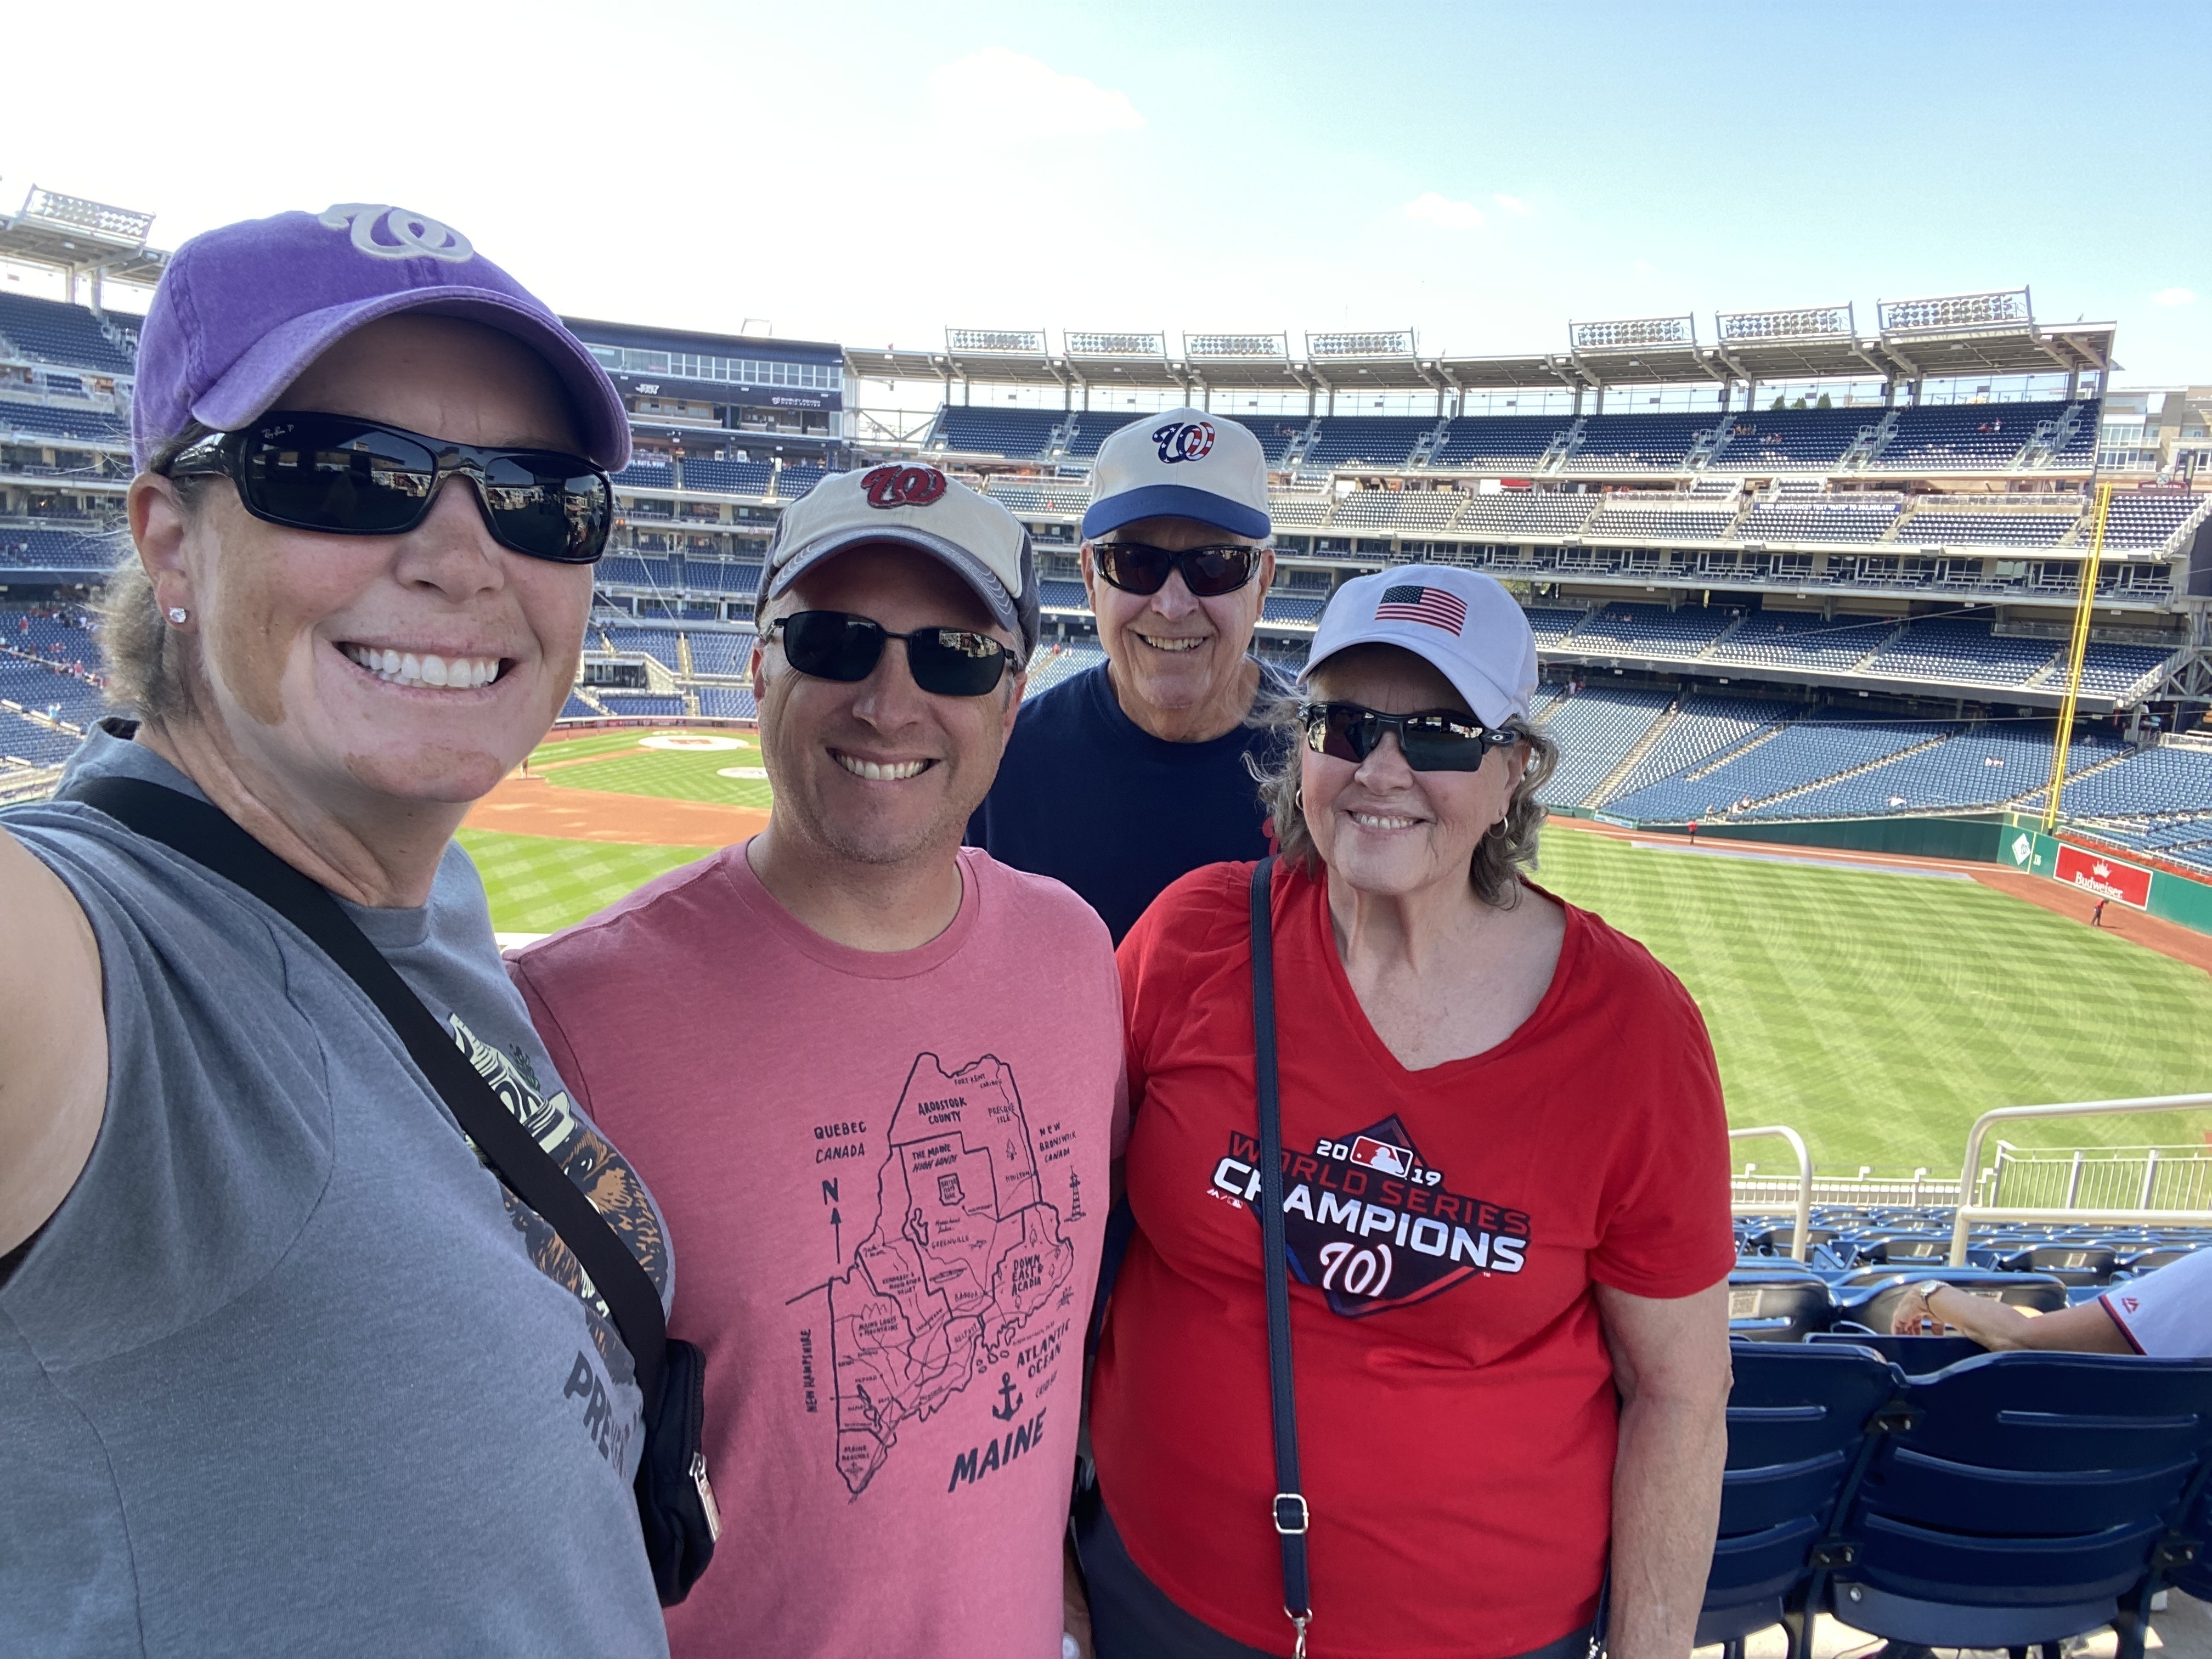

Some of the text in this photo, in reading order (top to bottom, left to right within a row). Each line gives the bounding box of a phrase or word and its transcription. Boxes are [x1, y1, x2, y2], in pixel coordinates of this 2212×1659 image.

[1152, 421, 1215, 464] W
[860, 465, 947, 509] W
[2075, 871, 2123, 899] Budweiser
[918, 1097, 967, 1115] AROOSTOOK
[988, 1103, 1015, 1116] PRESQUE
[928, 1111, 961, 1125] COUNTY
[997, 1114, 1011, 1124] ISLE
[814, 1121, 866, 1139] QUEBEC
[1040, 1122, 1060, 1137] NEW
[816, 1142, 865, 1164] CANADA
[912, 1143, 951, 1160] THE MAINE
[1045, 1147, 1070, 1163] CANADA
[1316, 1139, 1442, 1187] 20 19
[822, 1177, 839, 1205] N
[1380, 1180, 1530, 1235] SERIES
[932, 1235, 969, 1249] GREENVILLE
[1014, 1254, 1040, 1270] DOWN
[1012, 1266, 1034, 1282] EAST
[1011, 1277, 1041, 1296] ACADIA
[1017, 1318, 1071, 1369] ATLANTIC
[1028, 1342, 1062, 1378] OCEAN
[947, 1407, 1047, 1493] MAINE
